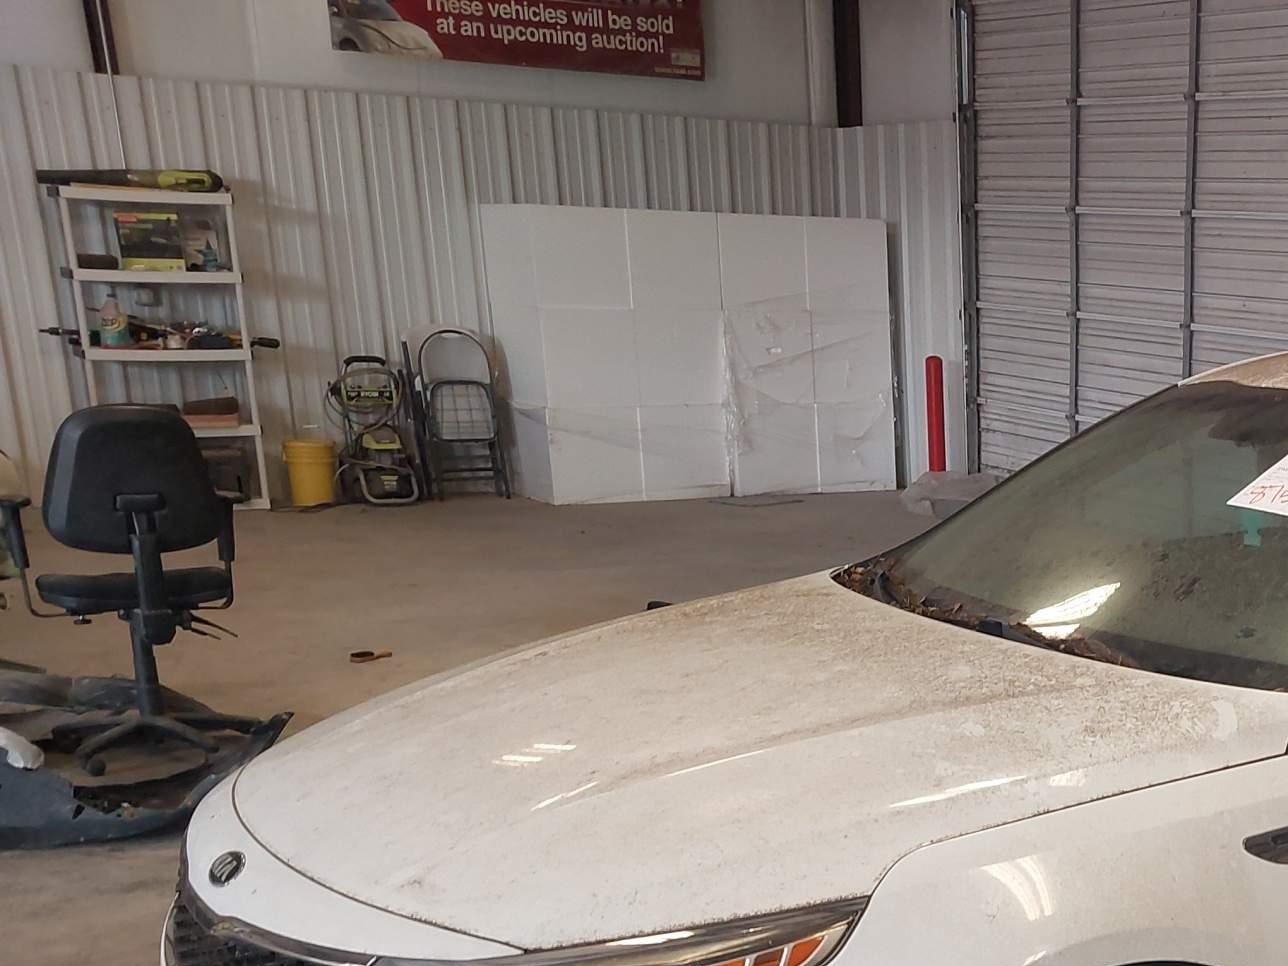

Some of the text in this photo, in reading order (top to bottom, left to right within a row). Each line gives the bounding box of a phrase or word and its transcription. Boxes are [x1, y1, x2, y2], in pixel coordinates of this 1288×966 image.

[436, 16, 664, 53] at an upcoming auction!
[487, 0, 568, 24] vehicles
[572, 8, 603, 28] will
[607, 10, 632, 30] be
[636, 14, 674, 34] sold
